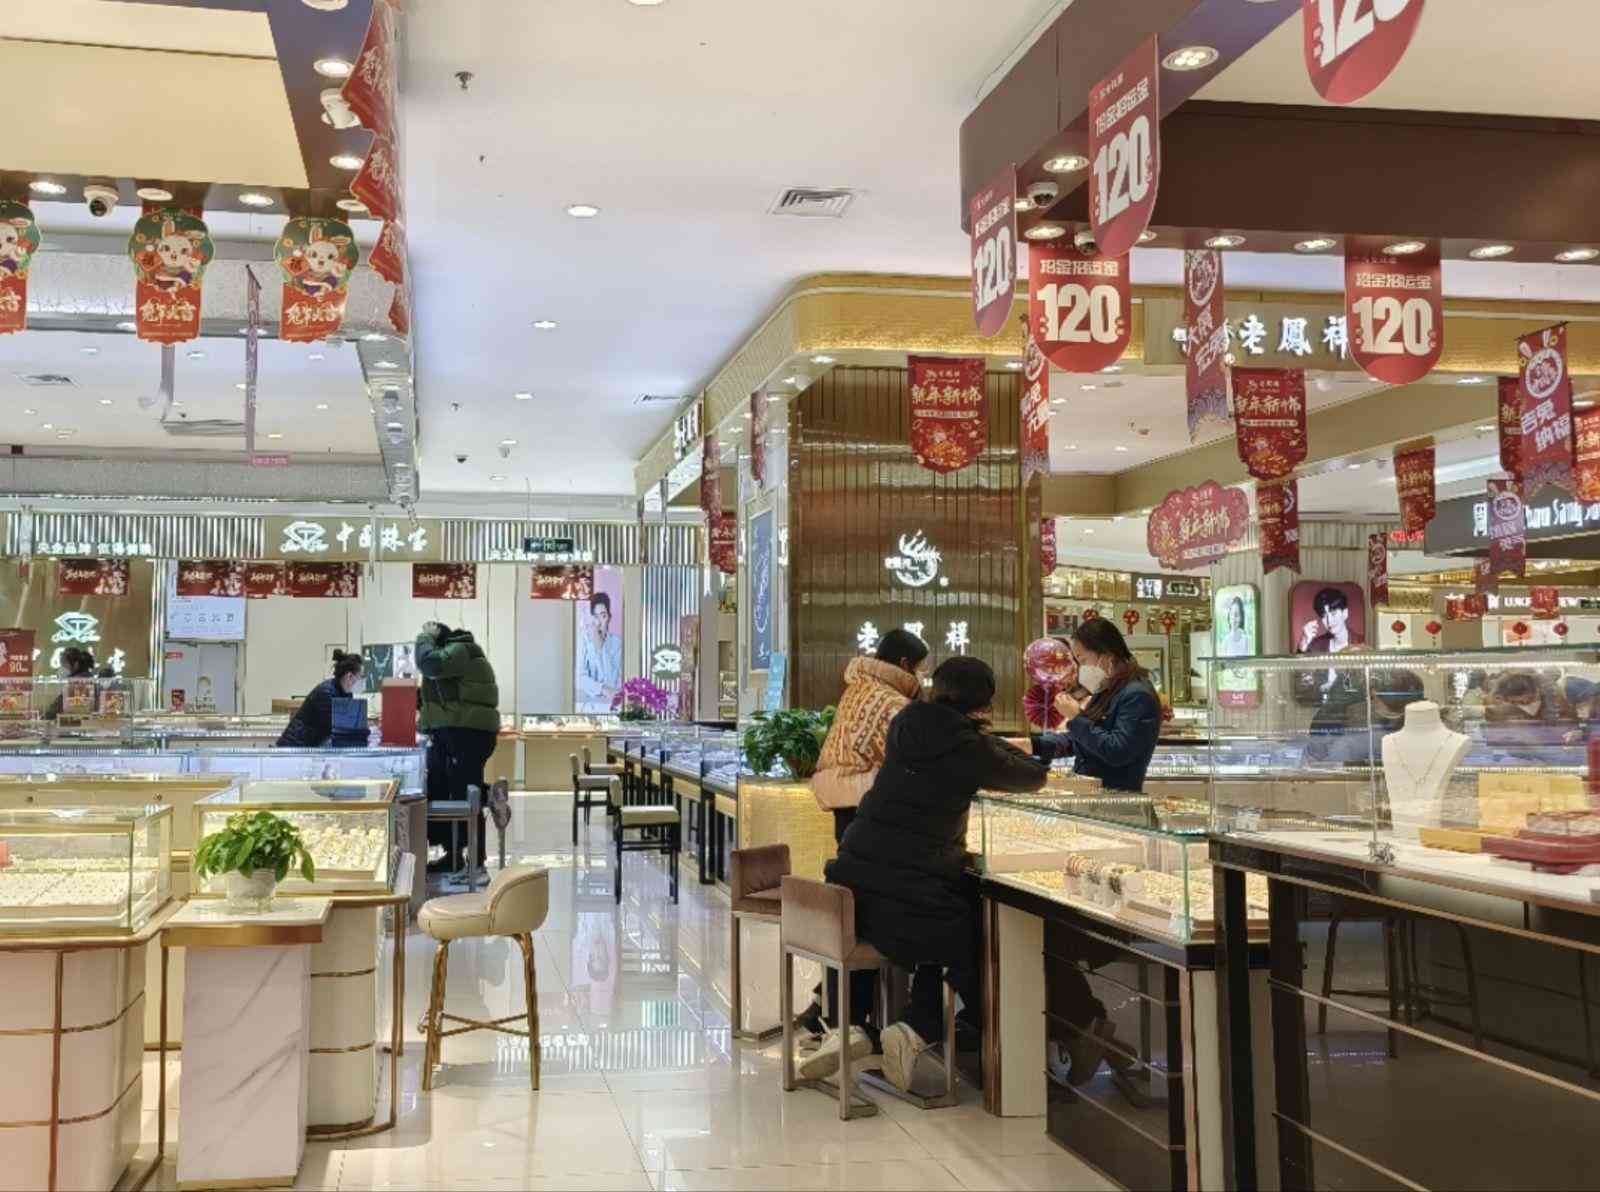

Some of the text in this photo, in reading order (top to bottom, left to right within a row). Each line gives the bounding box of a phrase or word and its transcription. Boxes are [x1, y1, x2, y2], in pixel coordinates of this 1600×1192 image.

[1313, 0, 1409, 68] 12
[1093, 115, 1151, 226] 120
[974, 225, 1012, 313] 120
[1036, 283, 1120, 344] 120
[1352, 296, 1433, 356] 120
[1525, 505, 1551, 529] how
